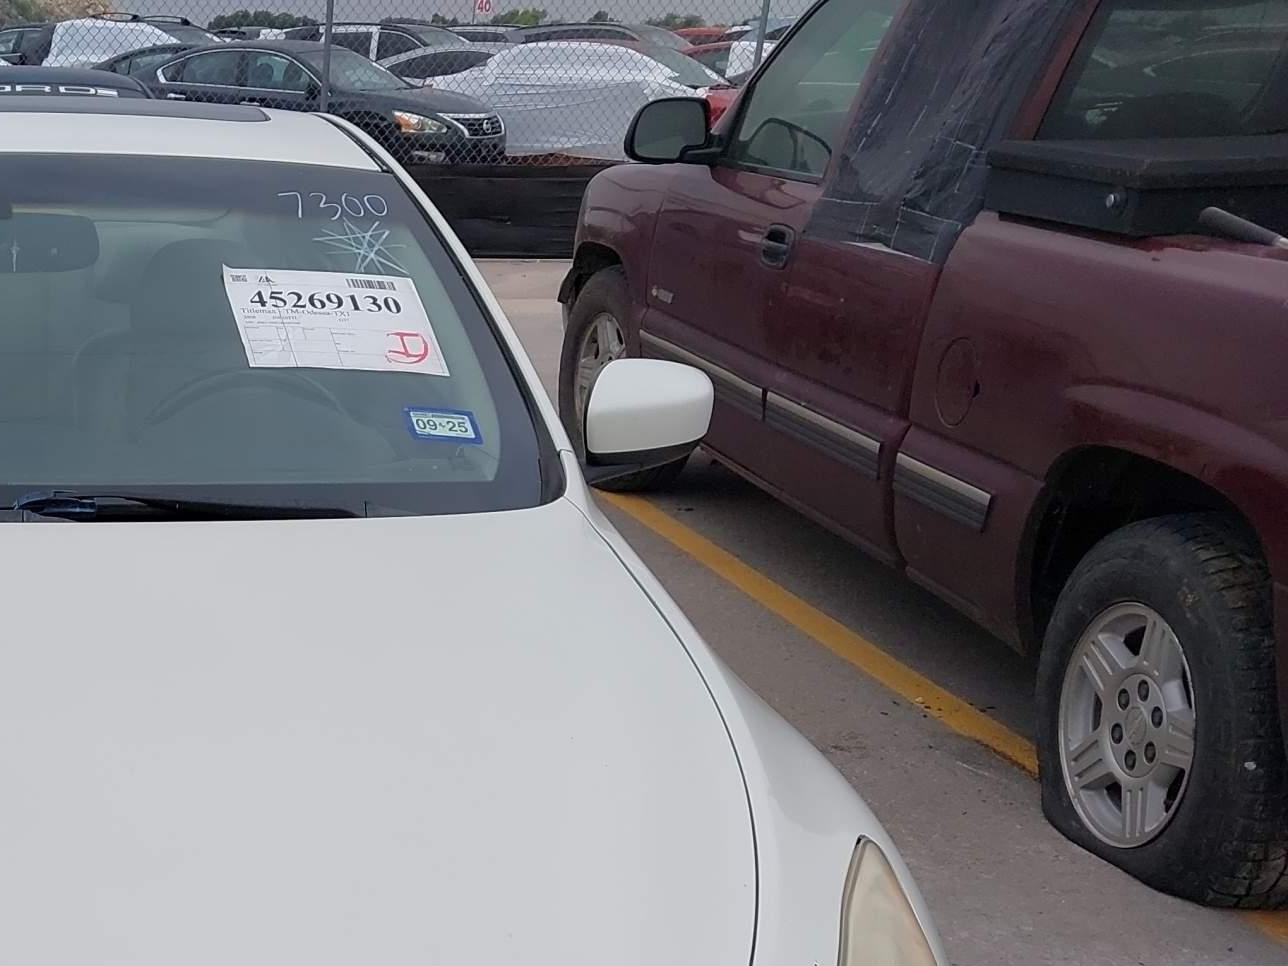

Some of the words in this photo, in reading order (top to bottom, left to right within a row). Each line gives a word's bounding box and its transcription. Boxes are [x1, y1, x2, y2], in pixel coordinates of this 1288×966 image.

[277, 191, 388, 221] 7300
[249, 290, 402, 315] 45269130
[415, 418, 438, 431] 09
[446, 420, 469, 433] 25
